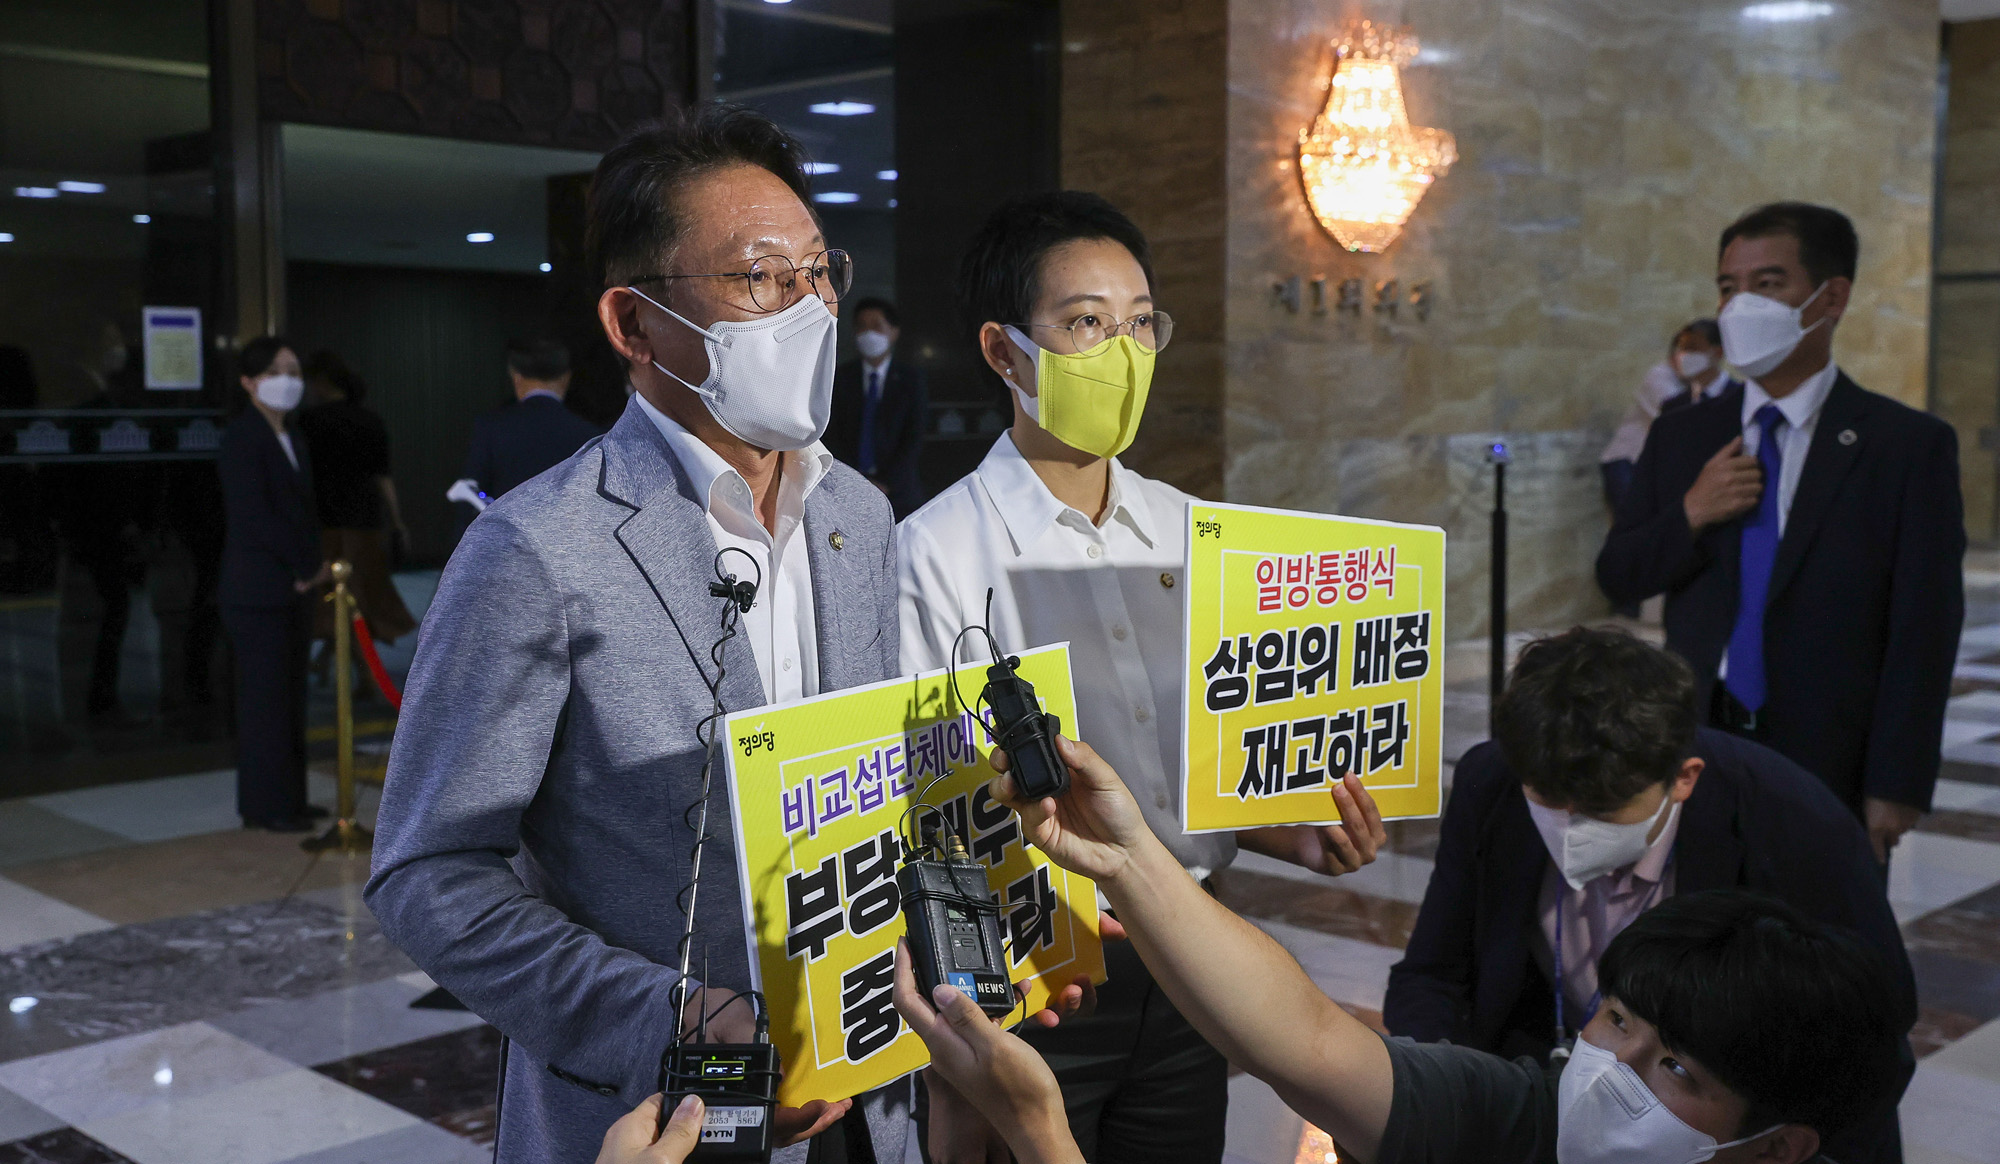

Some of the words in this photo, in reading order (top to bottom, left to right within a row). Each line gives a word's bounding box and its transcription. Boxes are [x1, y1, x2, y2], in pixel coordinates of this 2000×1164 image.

[1196, 521, 1221, 539] 정의당
[1257, 547, 1395, 612] 일방통행식
[1204, 624, 1340, 712] 상임위
[1352, 612, 1430, 687] 배정
[738, 731, 775, 757] 정의당
[1237, 701, 1408, 799] 재고하라
[782, 714, 976, 836] 비교섭단체에
[919, 783, 1032, 867] 대우
[977, 982, 1005, 994] NEWS
[708, 1117, 729, 1125] 2053
[713, 1130, 733, 1138] YTN
